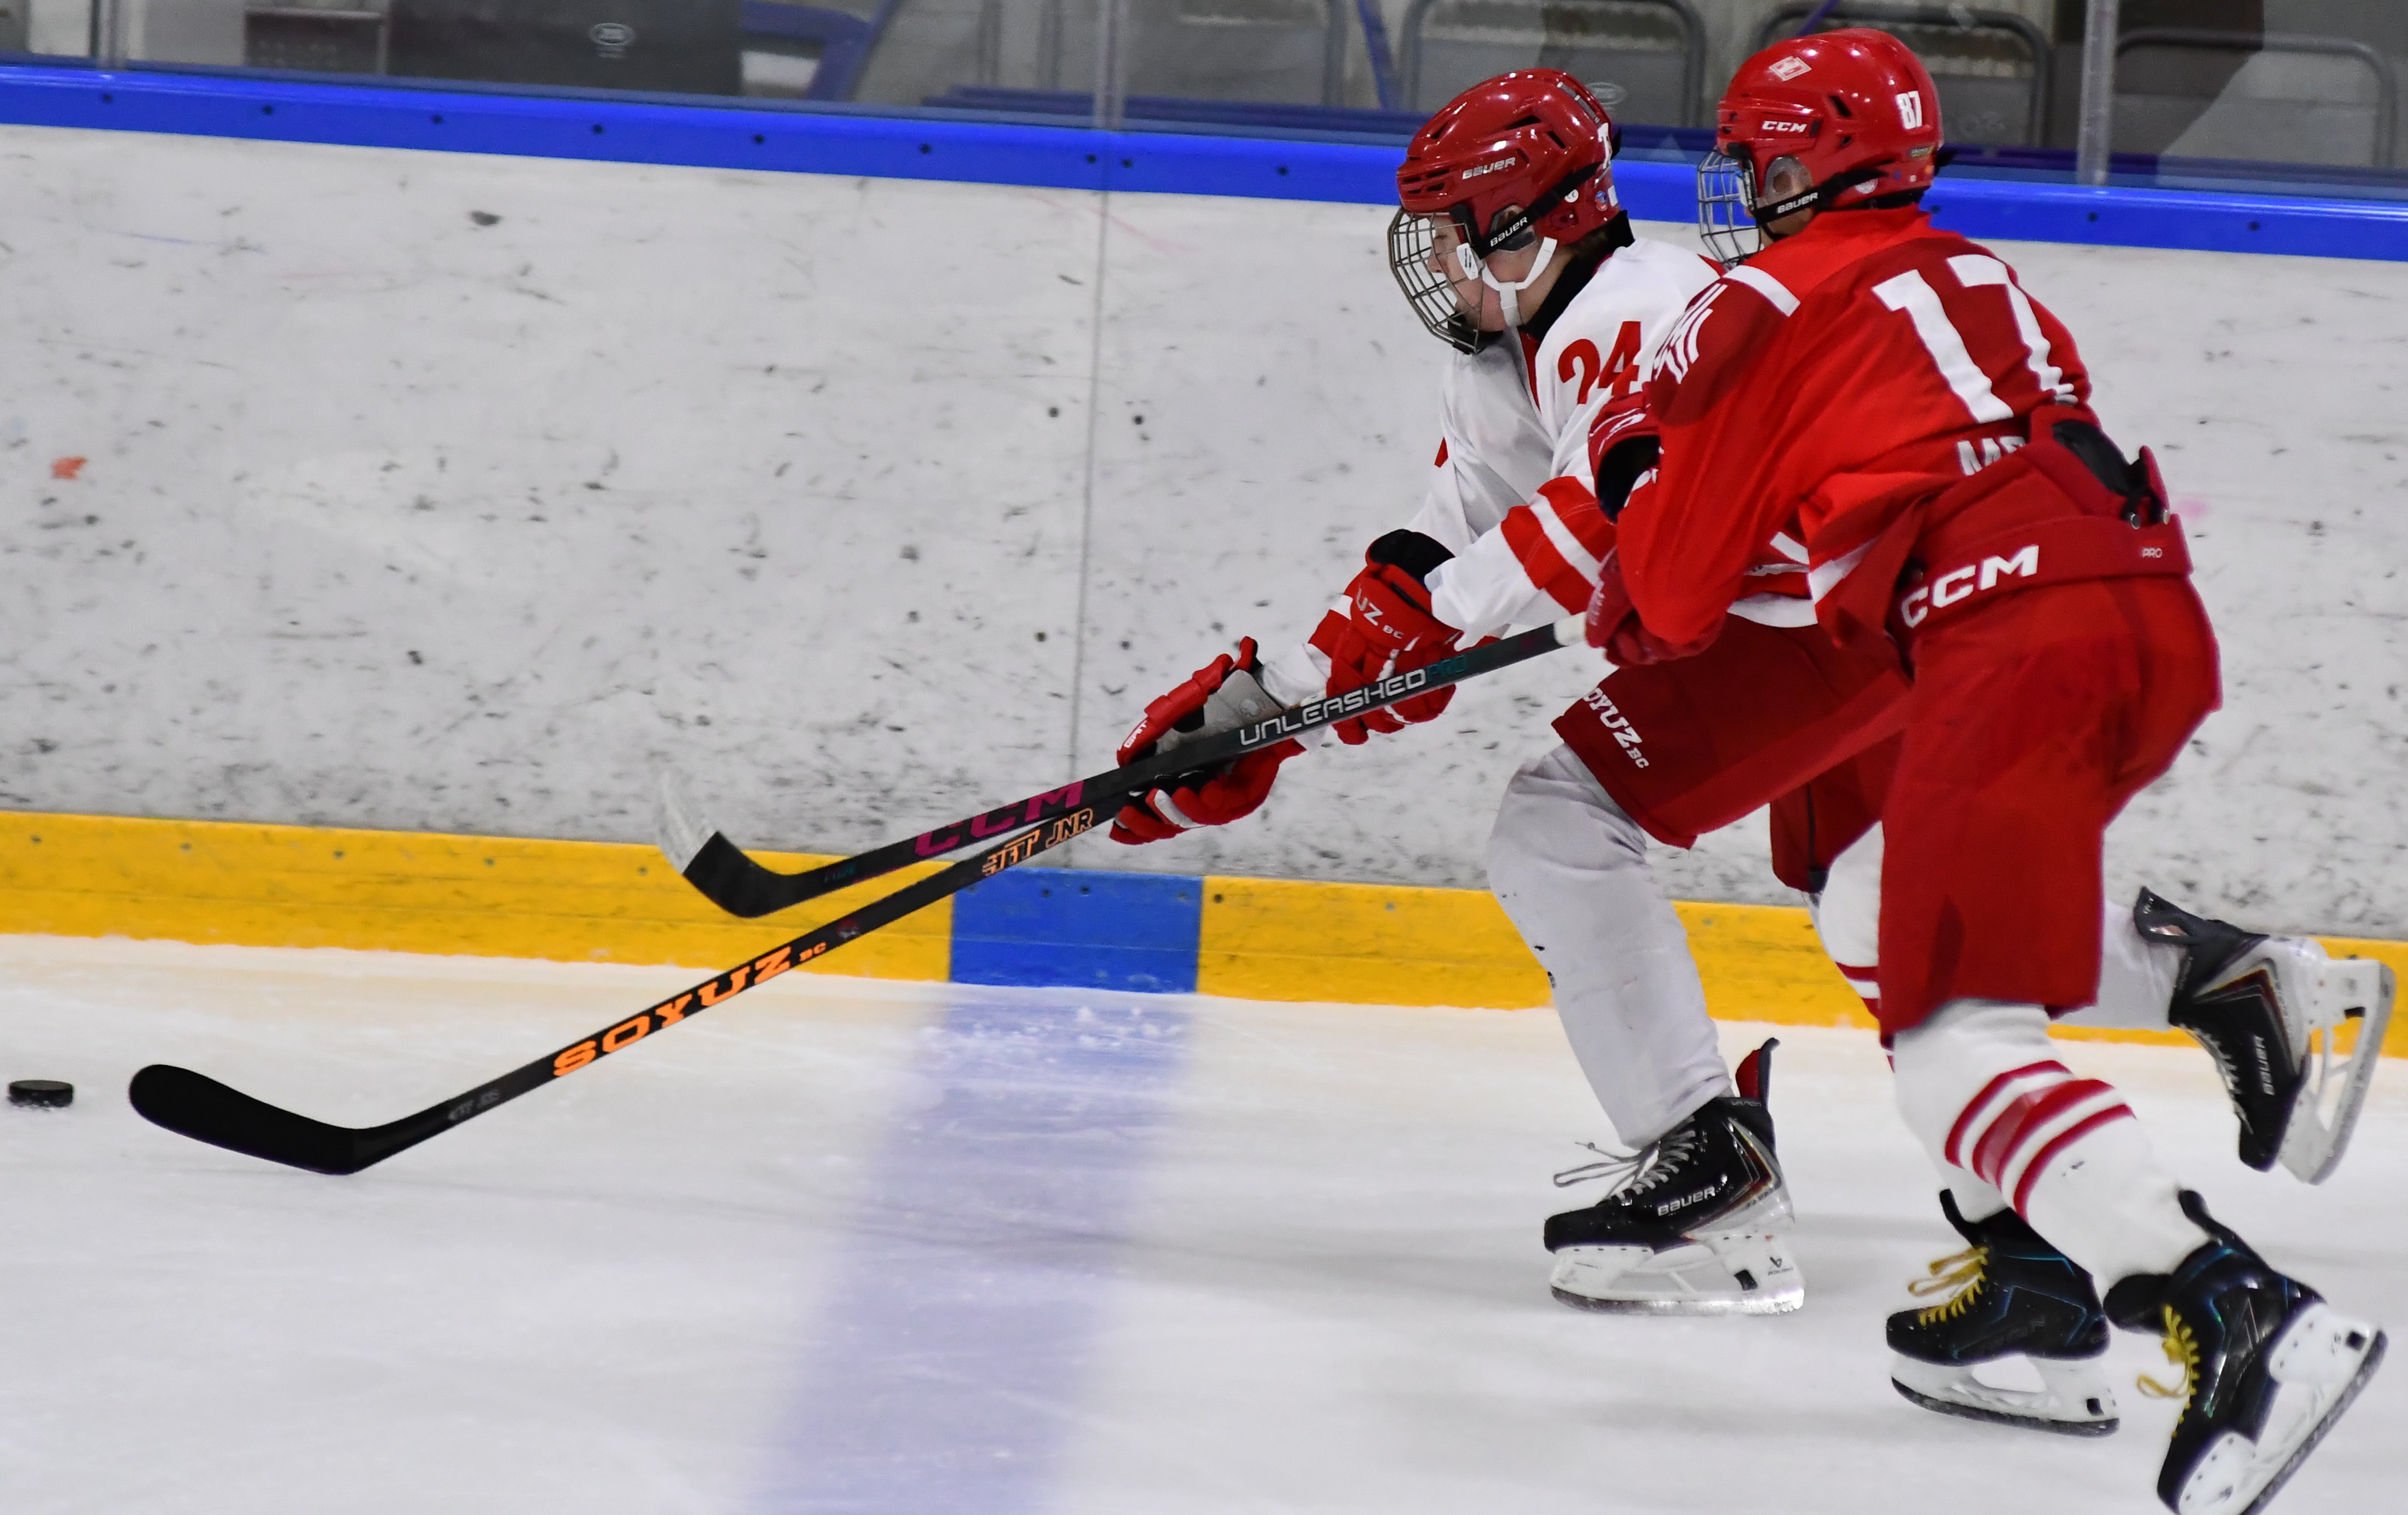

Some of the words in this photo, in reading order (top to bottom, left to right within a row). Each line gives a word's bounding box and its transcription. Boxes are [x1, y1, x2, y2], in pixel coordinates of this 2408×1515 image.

[1762, 120, 1808, 133] CCM
[1897, 90, 1922, 130] 87
[1462, 157, 1516, 180] BAUER
[1777, 192, 1818, 214] BAUER
[1490, 216, 1528, 247] BAUER
[1872, 254, 2078, 423] 17
[1558, 320, 1642, 405] 24
[2141, 546, 2163, 559] PRO
[1901, 544, 2040, 629] CCM
[1239, 669, 1427, 746] UNLEASHED
[1626, 747, 1650, 769] BC
[914, 780, 1085, 858] CCM
[1045, 808, 1094, 849] JNR
[553, 946, 792, 1078] SOYUZ
[799, 941, 828, 963] BC
[1656, 1185, 1716, 1217] BAUER
